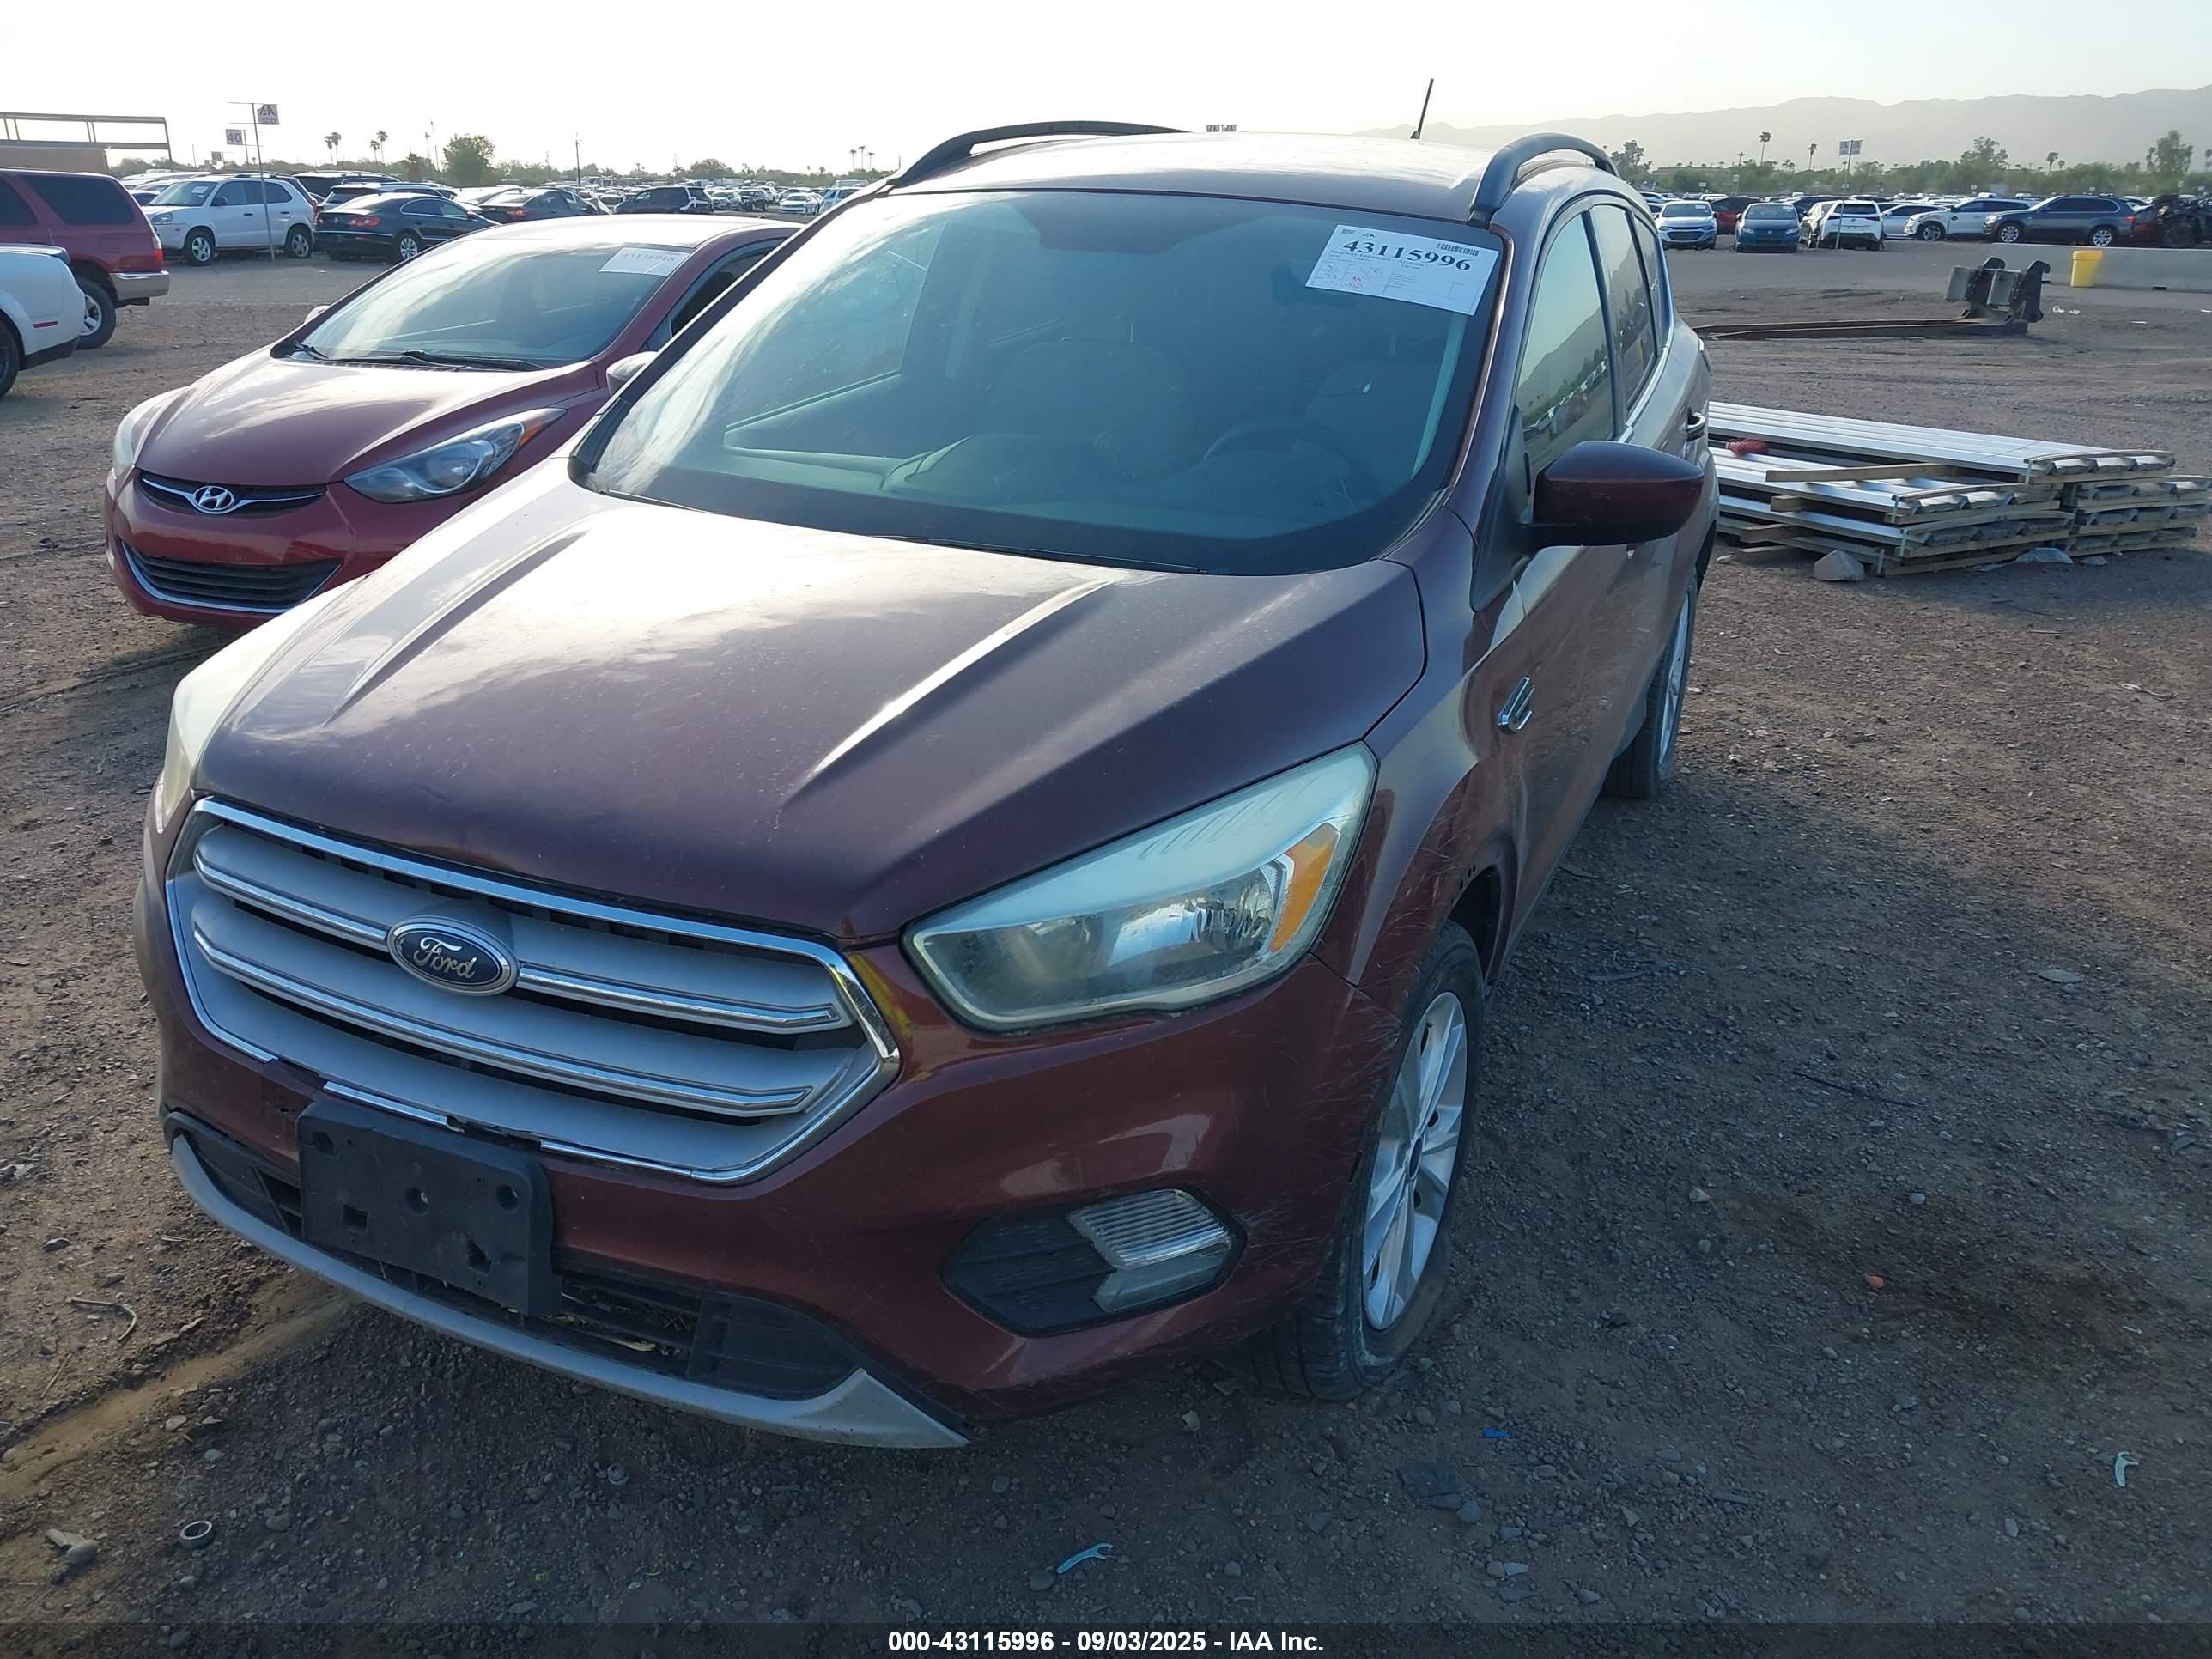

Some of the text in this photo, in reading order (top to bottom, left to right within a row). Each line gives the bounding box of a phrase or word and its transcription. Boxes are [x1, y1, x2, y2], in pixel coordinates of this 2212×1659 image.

[227, 132, 242, 143] 40
[1343, 240, 1471, 270] 43115996
[413, 936, 477, 978] Ford
